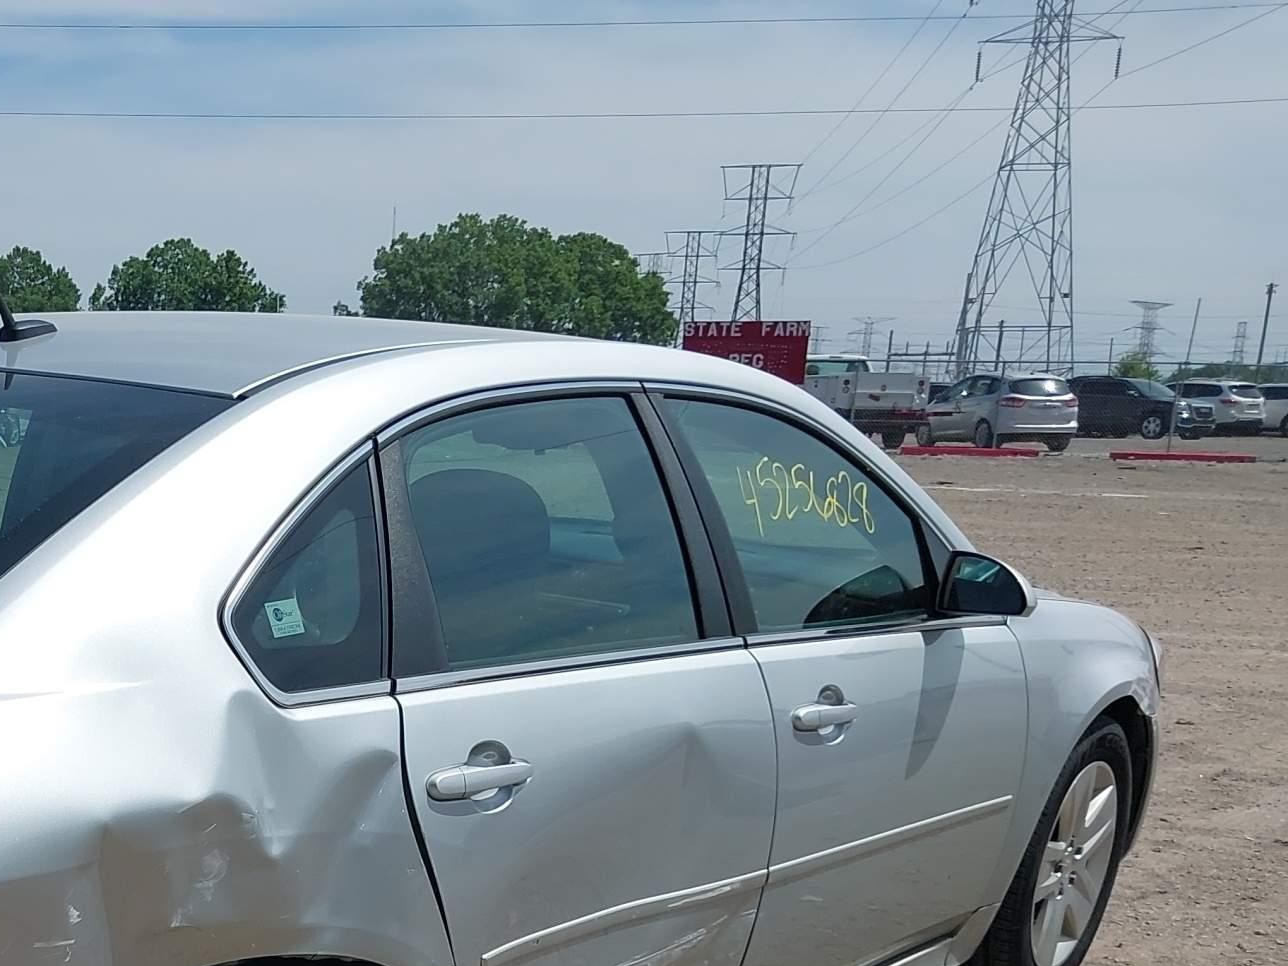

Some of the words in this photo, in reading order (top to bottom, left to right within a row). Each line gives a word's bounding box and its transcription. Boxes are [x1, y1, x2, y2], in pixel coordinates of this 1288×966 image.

[683, 322, 744, 338] STATE
[761, 321, 811, 338] FARM
[736, 455, 876, 538] 45256828
